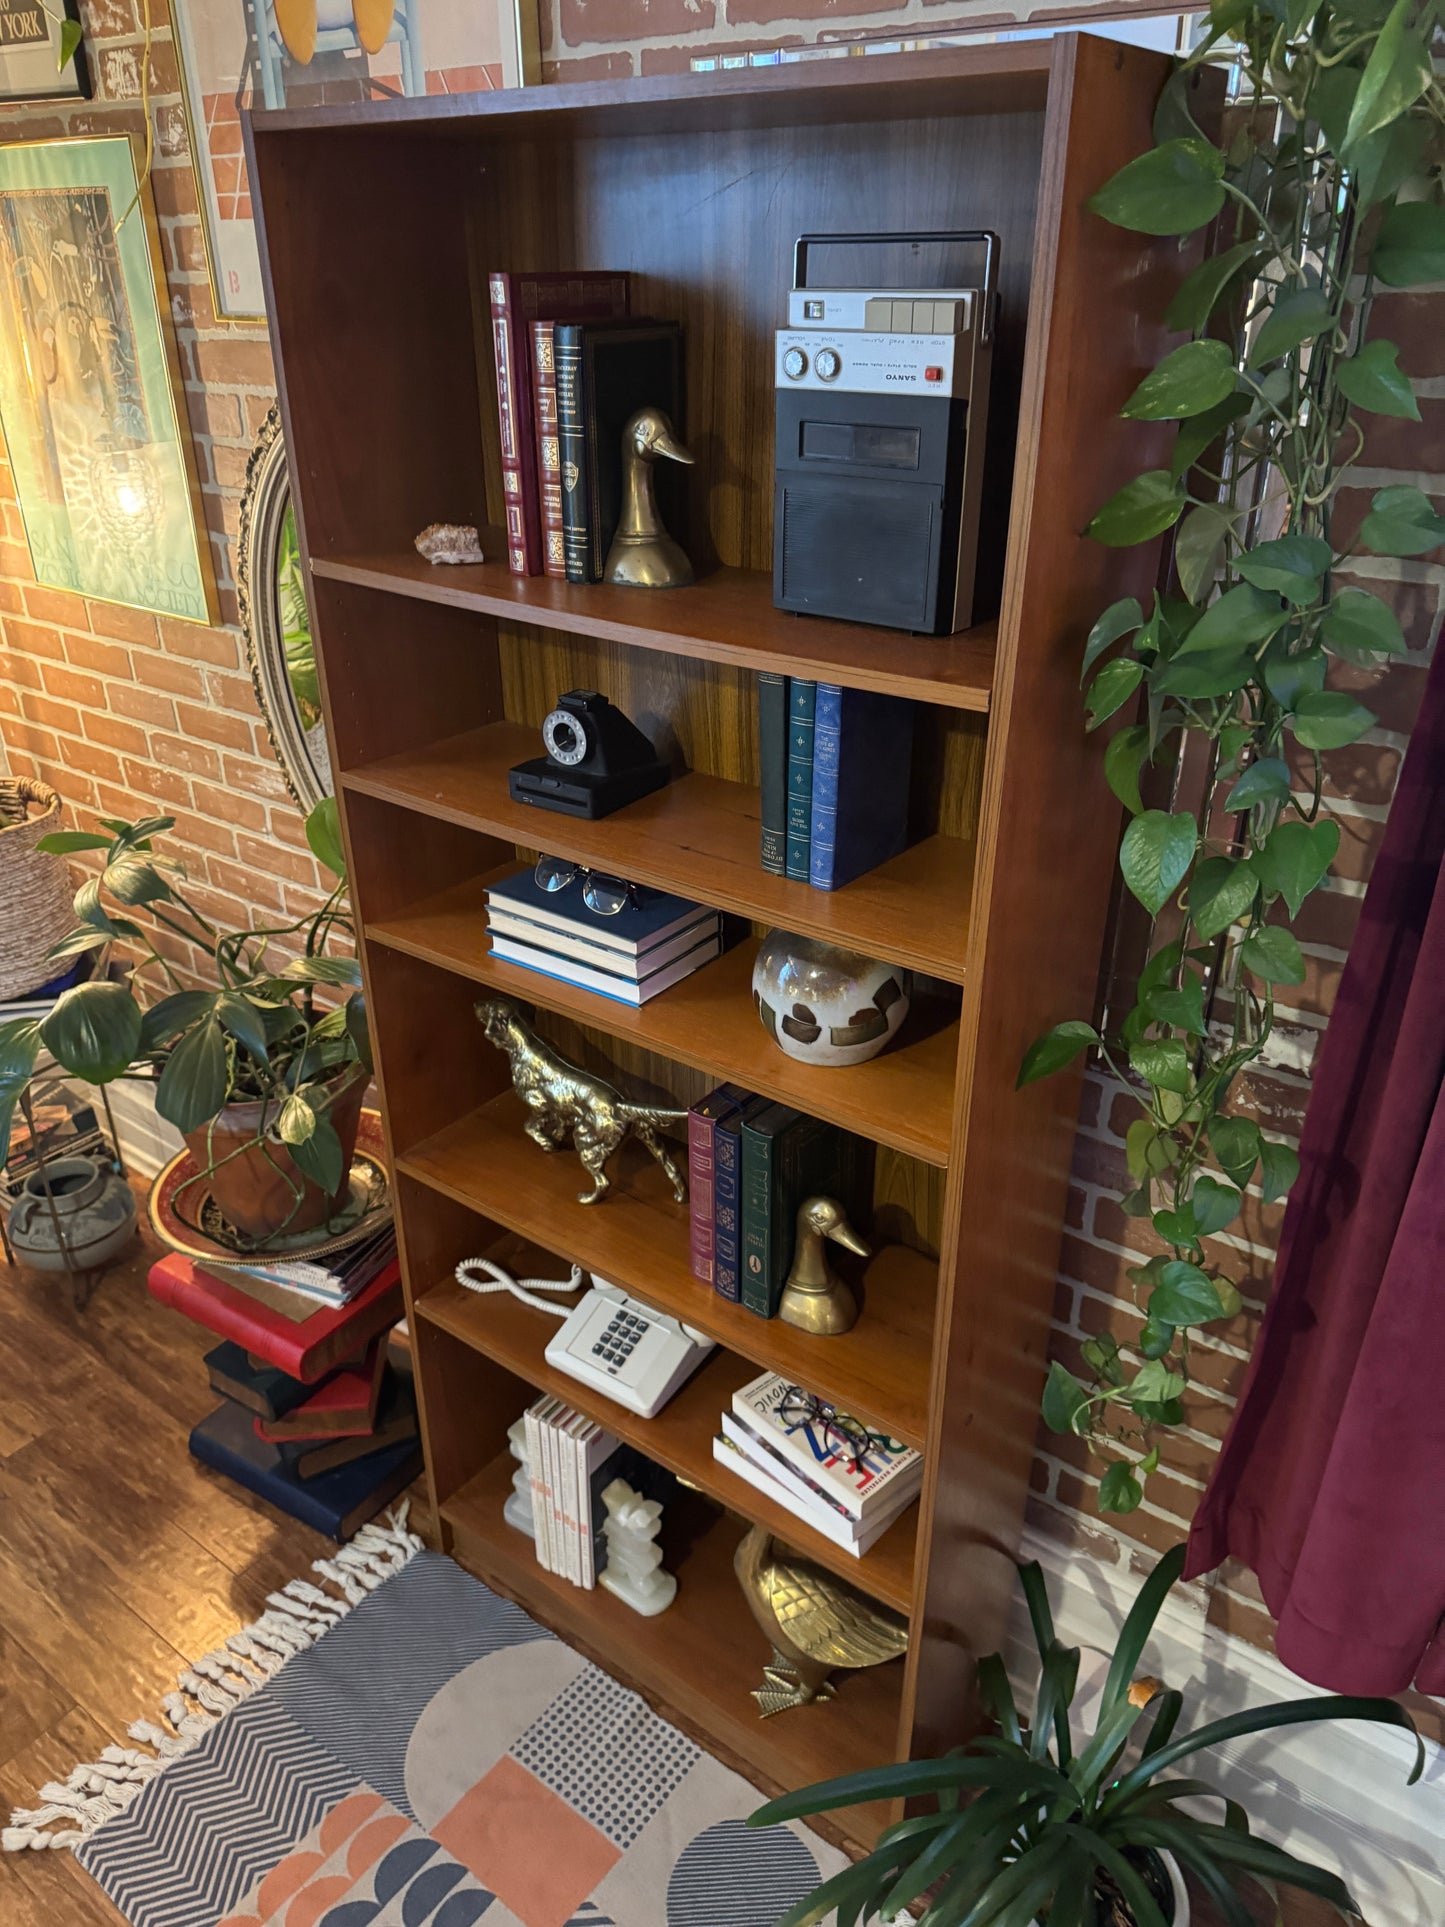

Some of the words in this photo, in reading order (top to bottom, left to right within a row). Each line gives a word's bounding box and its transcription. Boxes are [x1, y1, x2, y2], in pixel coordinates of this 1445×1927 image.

[3, 11, 43, 39] YORK
[31, 530, 74, 564] SAN
[891, 1455, 908, 1471] TIMES
[861, 1470, 892, 1497] BESTSELLER
